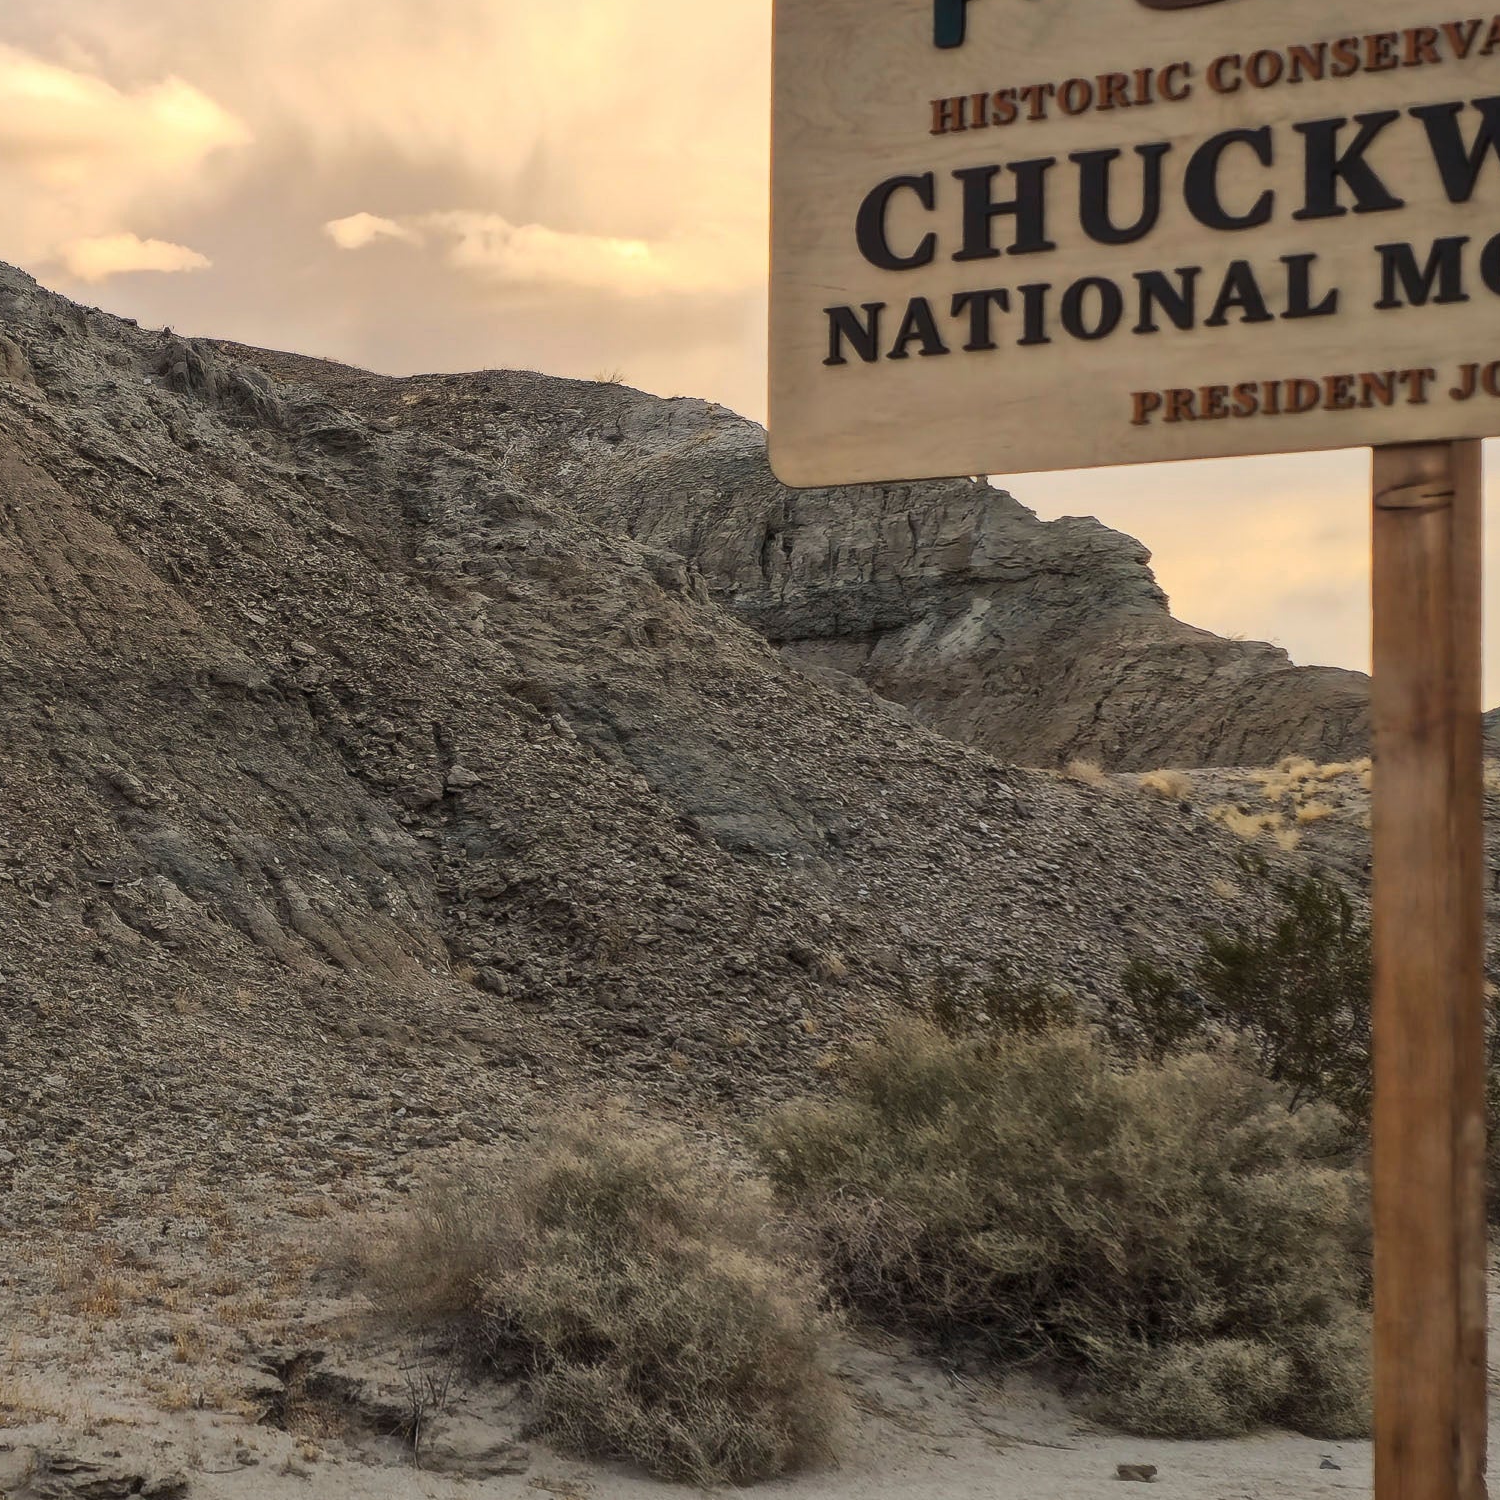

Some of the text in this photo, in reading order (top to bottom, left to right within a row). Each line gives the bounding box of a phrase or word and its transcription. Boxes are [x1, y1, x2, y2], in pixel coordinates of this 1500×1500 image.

[930, 61, 1194, 136] HISTORIC
[822, 252, 1342, 366] NATIONAL
[1130, 367, 1437, 426] PRESIDENT
